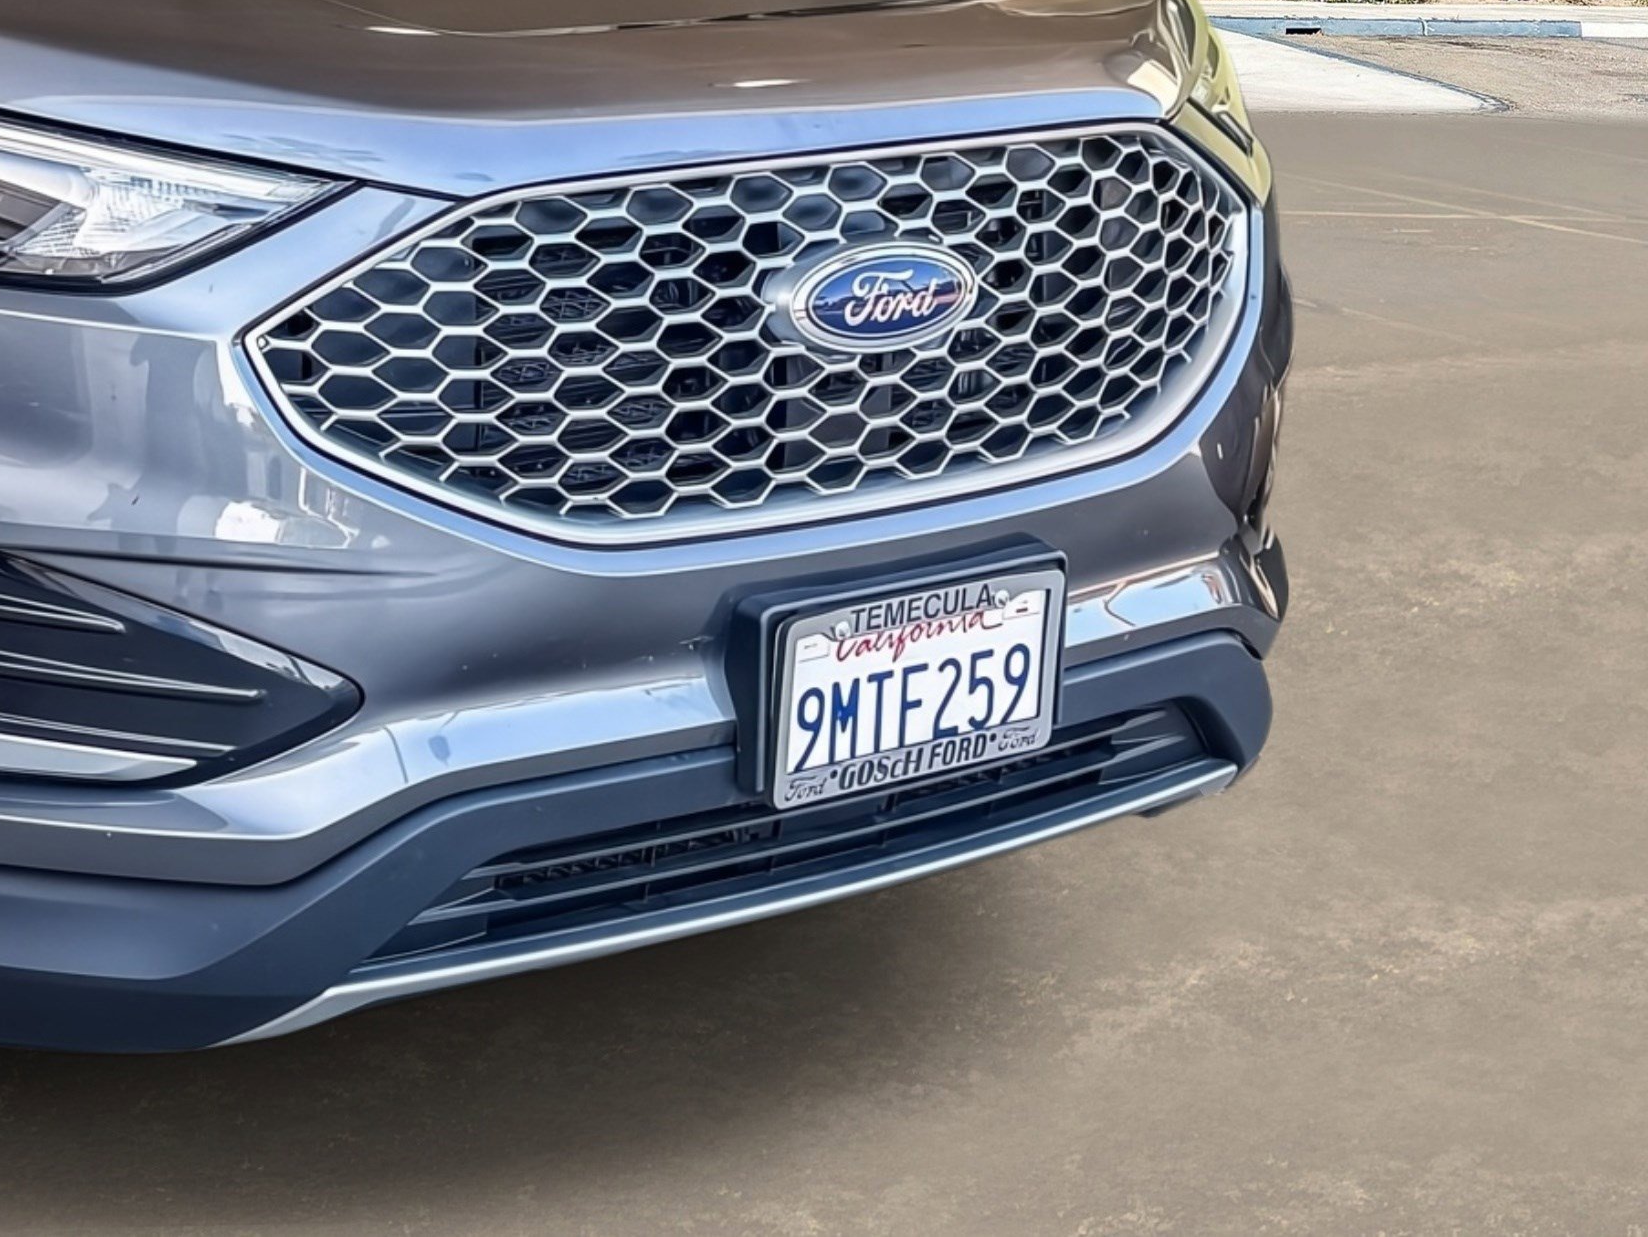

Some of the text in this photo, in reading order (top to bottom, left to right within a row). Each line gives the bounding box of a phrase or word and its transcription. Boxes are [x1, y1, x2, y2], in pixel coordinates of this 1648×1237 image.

[844, 269, 939, 326] Ford
[835, 610, 1003, 662] California
[852, 584, 992, 633] TEMECULA
[794, 643, 1031, 773] 9MTF259
[785, 776, 827, 801] Ford
[928, 734, 987, 770] FORD
[998, 726, 1038, 750] Ford
